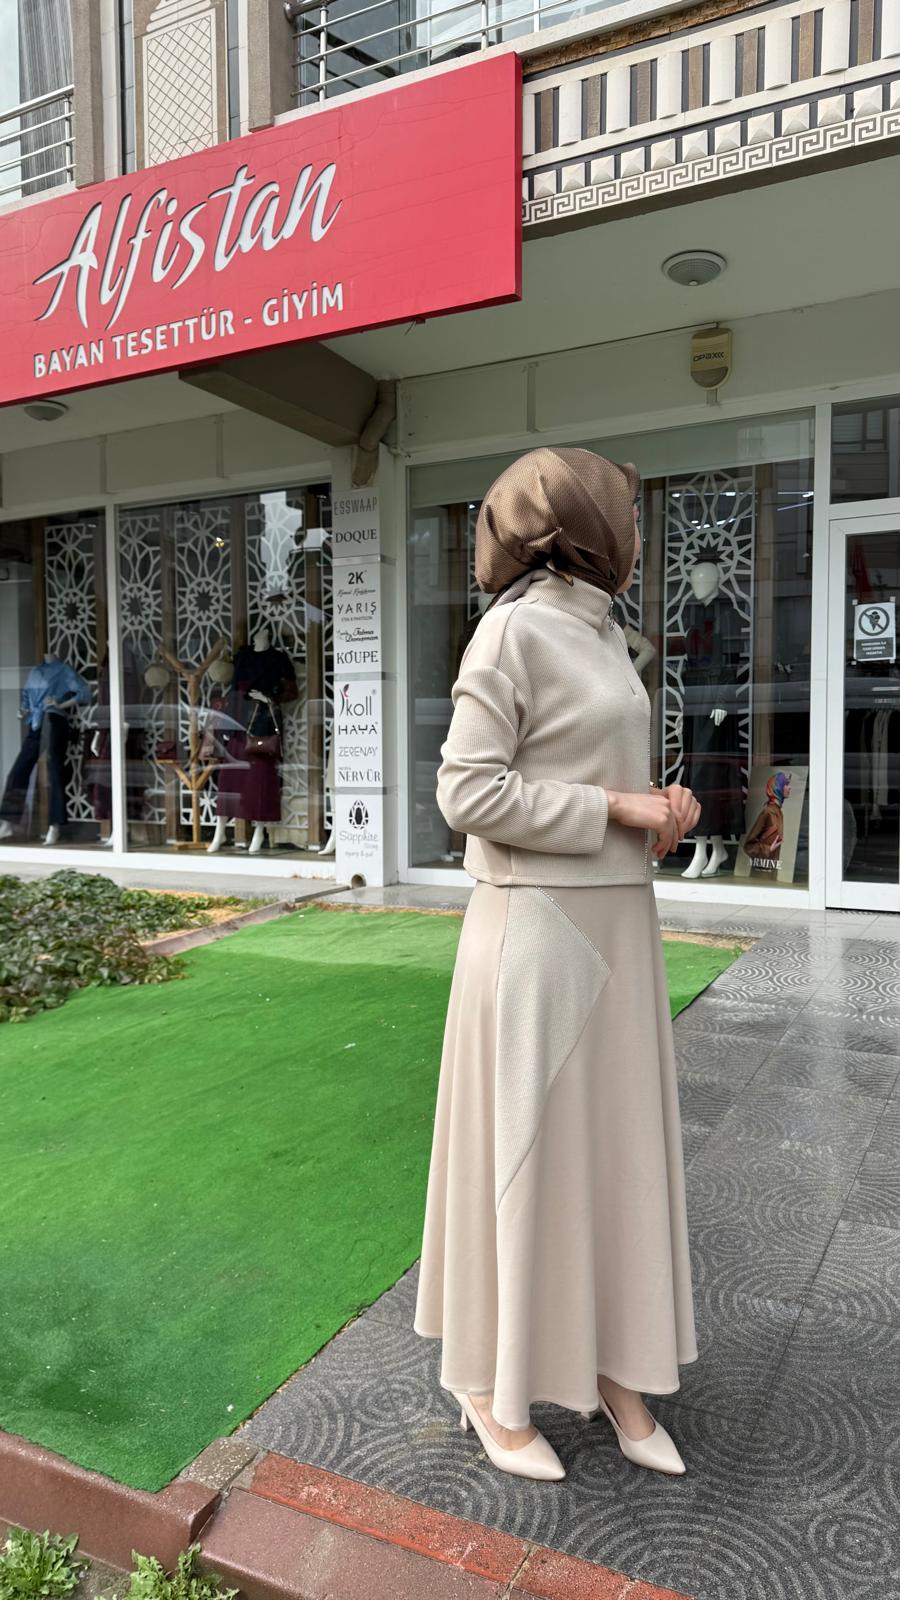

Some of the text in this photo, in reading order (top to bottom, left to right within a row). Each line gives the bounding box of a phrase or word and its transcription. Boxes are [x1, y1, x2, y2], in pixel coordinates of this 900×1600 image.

[32, 162, 343, 330] Alfistan
[33, 340, 104, 379] BAYAN
[111, 309, 235, 361] TESETTÜR
[262, 282, 345, 327] GİYİM
[335, 528, 377, 544] DOQUE
[348, 571, 364, 585] 2K
[337, 601, 377, 615] YARIŞ
